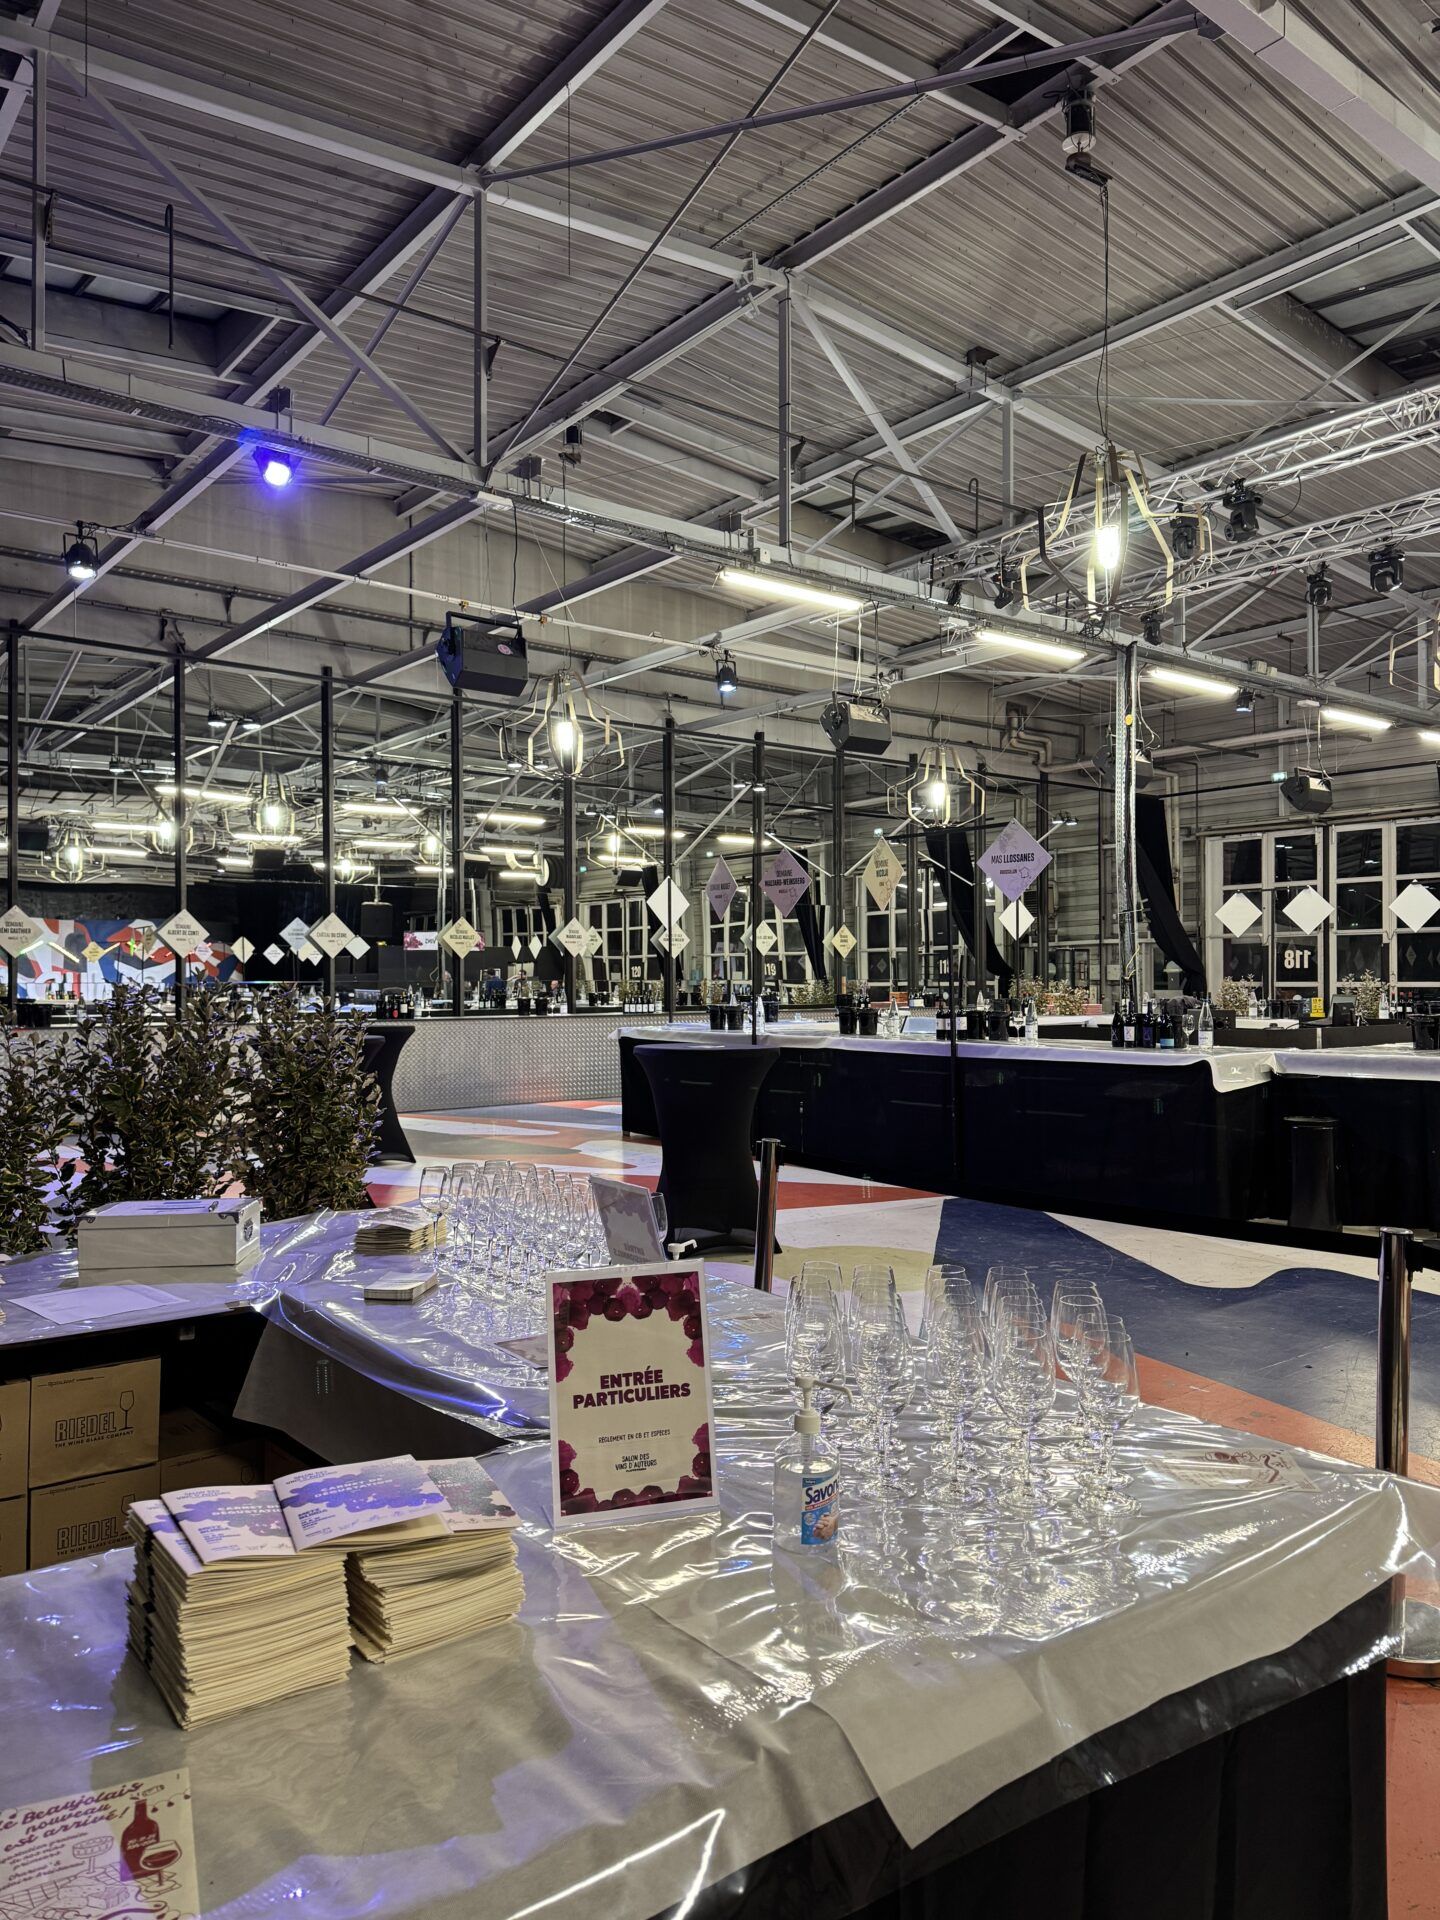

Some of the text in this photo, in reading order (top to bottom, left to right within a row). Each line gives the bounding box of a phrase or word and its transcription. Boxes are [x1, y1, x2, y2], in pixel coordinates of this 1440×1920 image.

[1004, 853, 1035, 863] LLOSSANES
[631, 966, 642, 977] 120
[600, 1365, 663, 1390] ENTRÉE
[573, 1383, 691, 1409] PARTICULIERS
[54, 1411, 117, 1443] RIEDEL
[615, 1463, 627, 1471] VINS
[57, 1517, 118, 1550] RIEDEL
[22, 1782, 144, 1826] Beaujolais
[25, 1803, 112, 1835] nouveau
[4, 1835, 39, 1852] est
